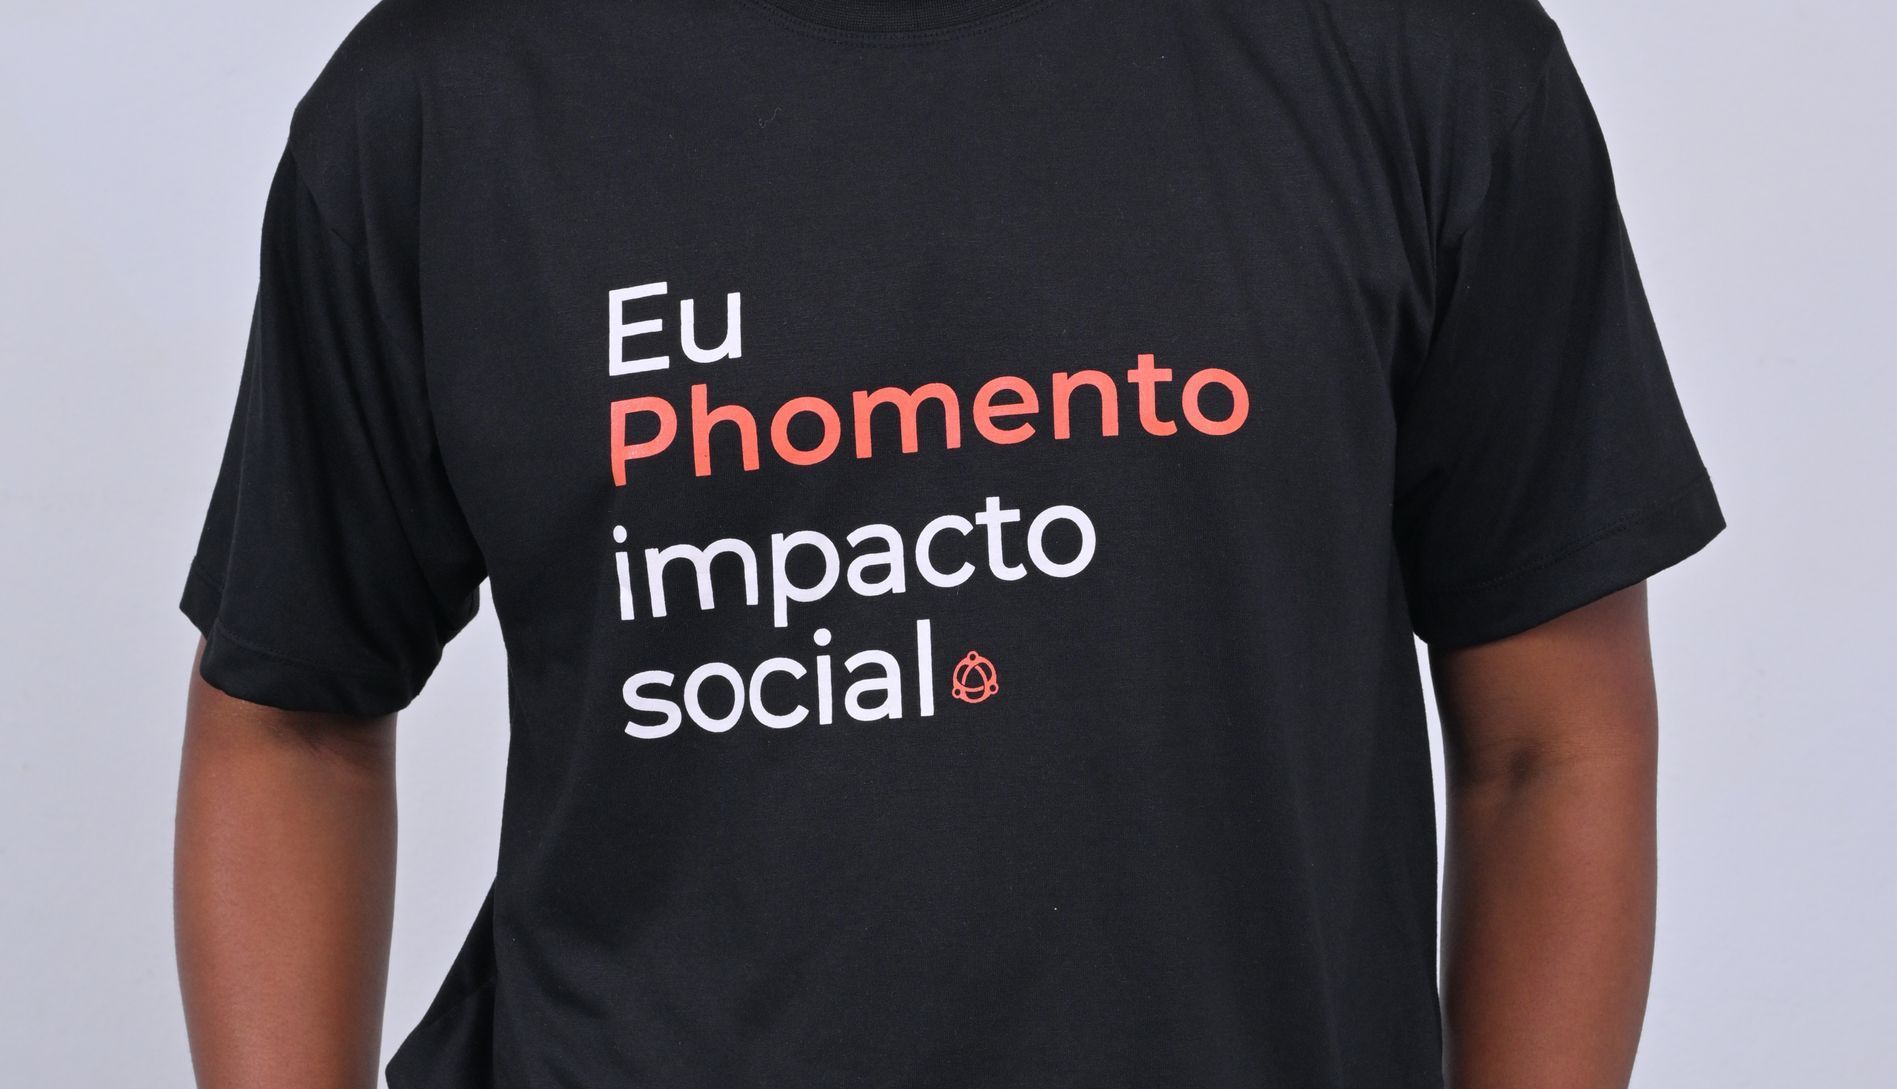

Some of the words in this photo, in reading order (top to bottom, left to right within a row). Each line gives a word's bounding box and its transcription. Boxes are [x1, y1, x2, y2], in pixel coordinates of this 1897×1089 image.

[608, 281, 743, 377] Eu
[610, 353, 1250, 487] Phomento
[612, 495, 1097, 628] impacto
[622, 618, 935, 740] social
